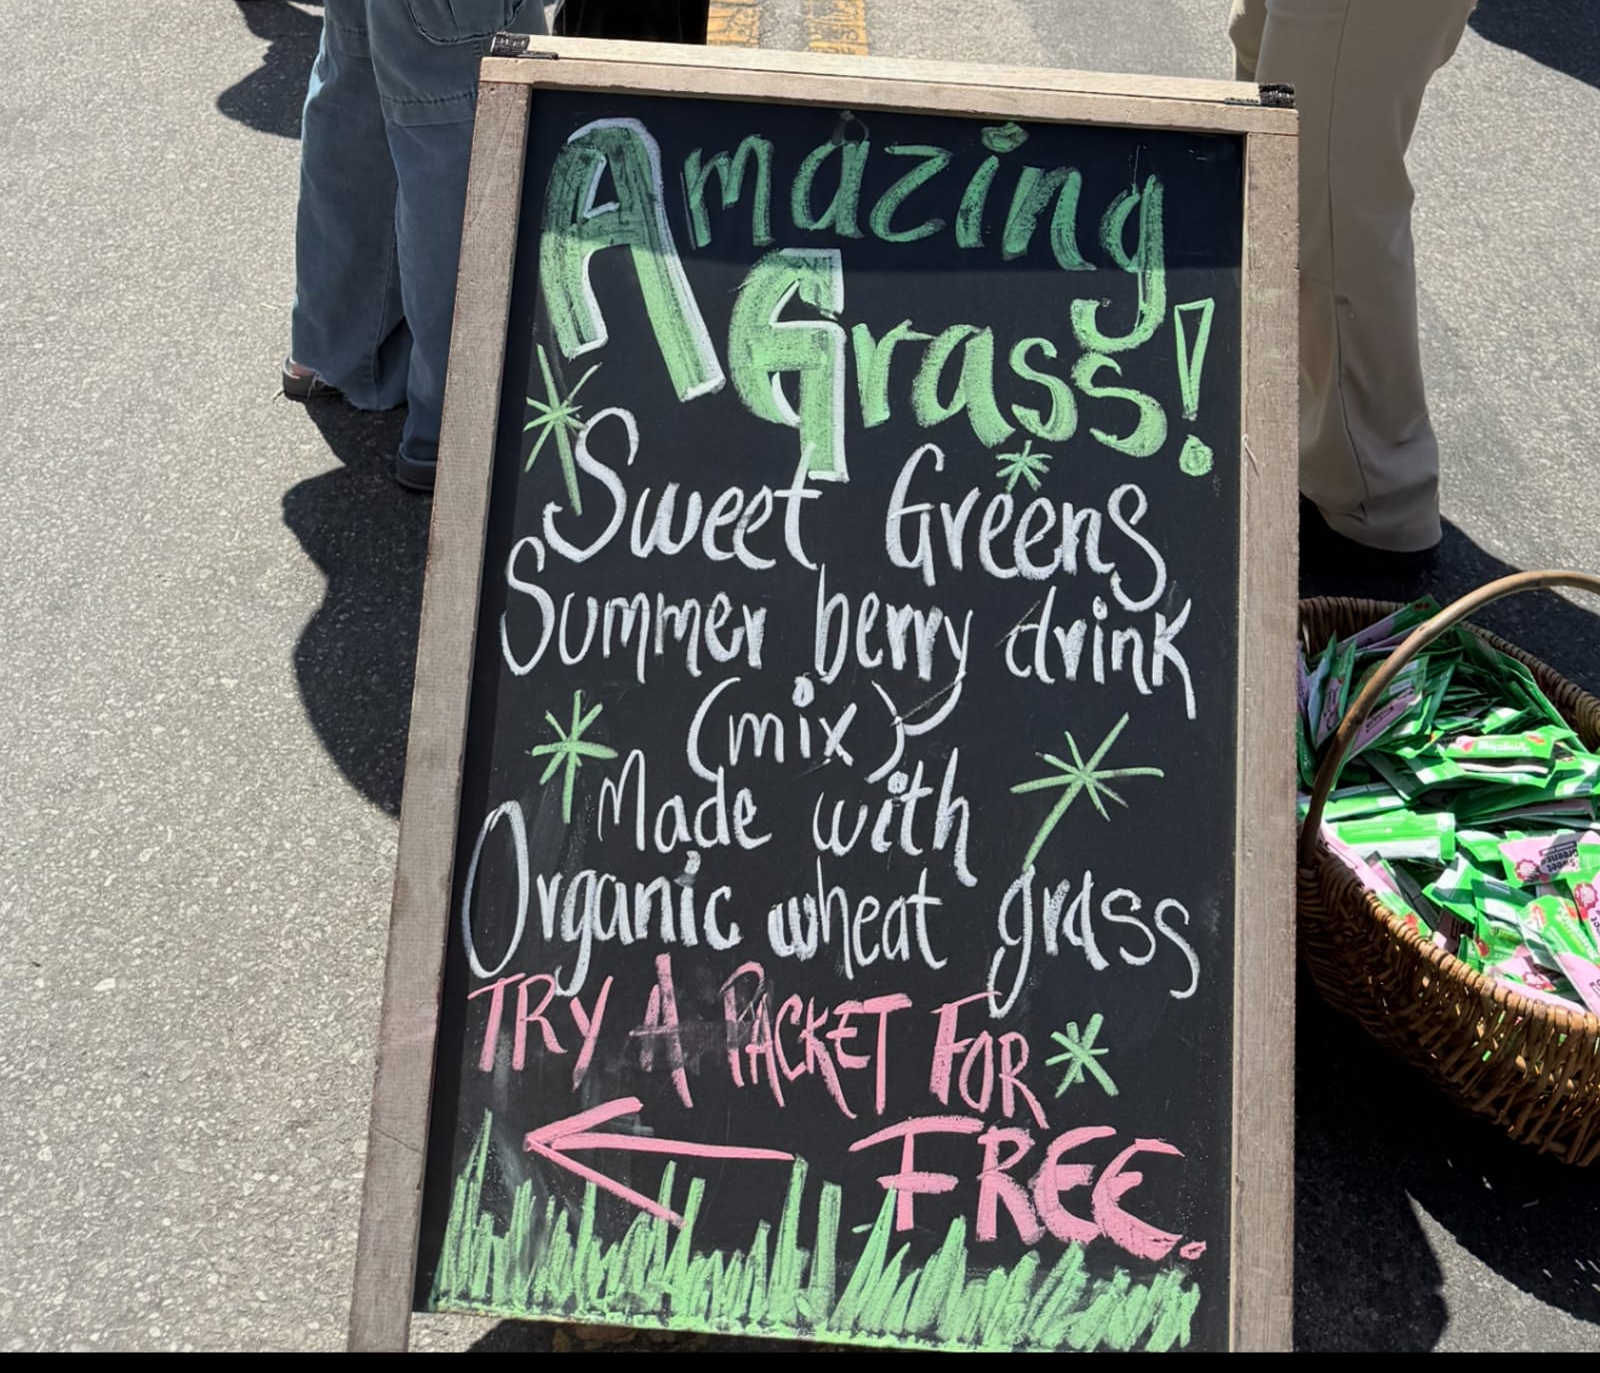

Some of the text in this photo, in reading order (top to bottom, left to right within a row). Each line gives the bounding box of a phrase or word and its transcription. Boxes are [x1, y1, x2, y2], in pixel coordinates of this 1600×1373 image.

[539, 113, 1166, 402] Amazing
[727, 248, 1215, 484] Grass!
[542, 407, 1167, 612] Sweet Greens
[500, 536, 1198, 736] Summer berry drink
[687, 676, 906, 784] (mix)
[463, 801, 1200, 1017] Organic wheat grass
[598, 747, 977, 888] Made with
[469, 953, 1049, 1129] TRY A PACKET FOR
